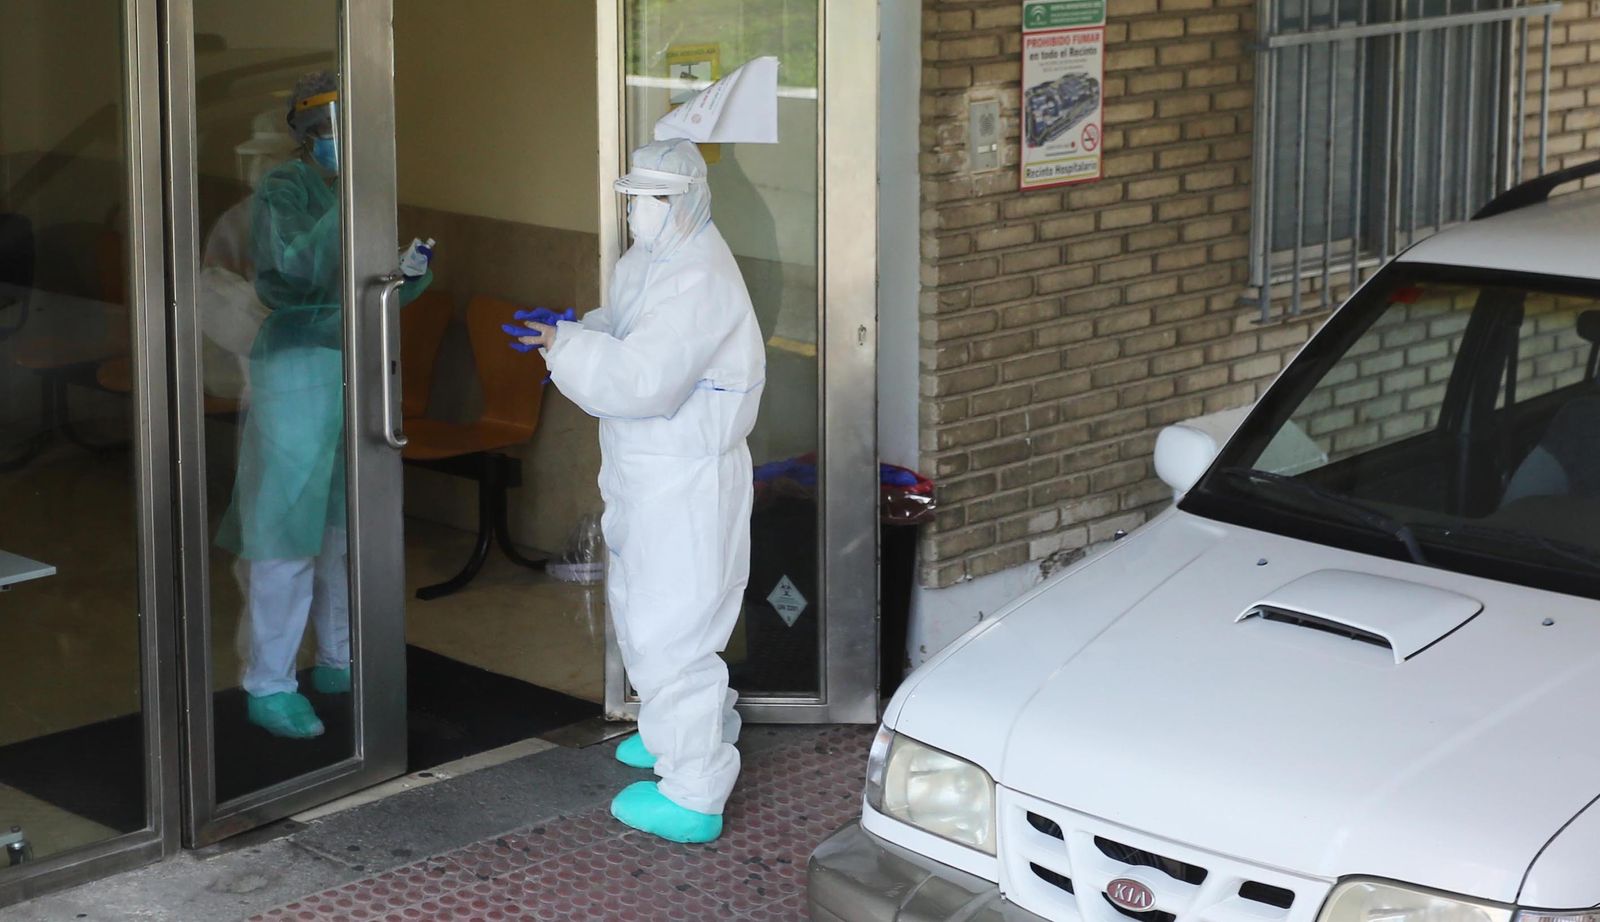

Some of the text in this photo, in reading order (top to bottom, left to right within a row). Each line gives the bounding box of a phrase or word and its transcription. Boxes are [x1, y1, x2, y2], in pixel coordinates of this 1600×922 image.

[1026, 32, 1100, 48] PROHIBIDO FUMAR
[1029, 46, 1097, 61] en todo el Recinto
[1026, 161, 1097, 179] Recinto Hospitalario
[1114, 883, 1146, 907] KIA
